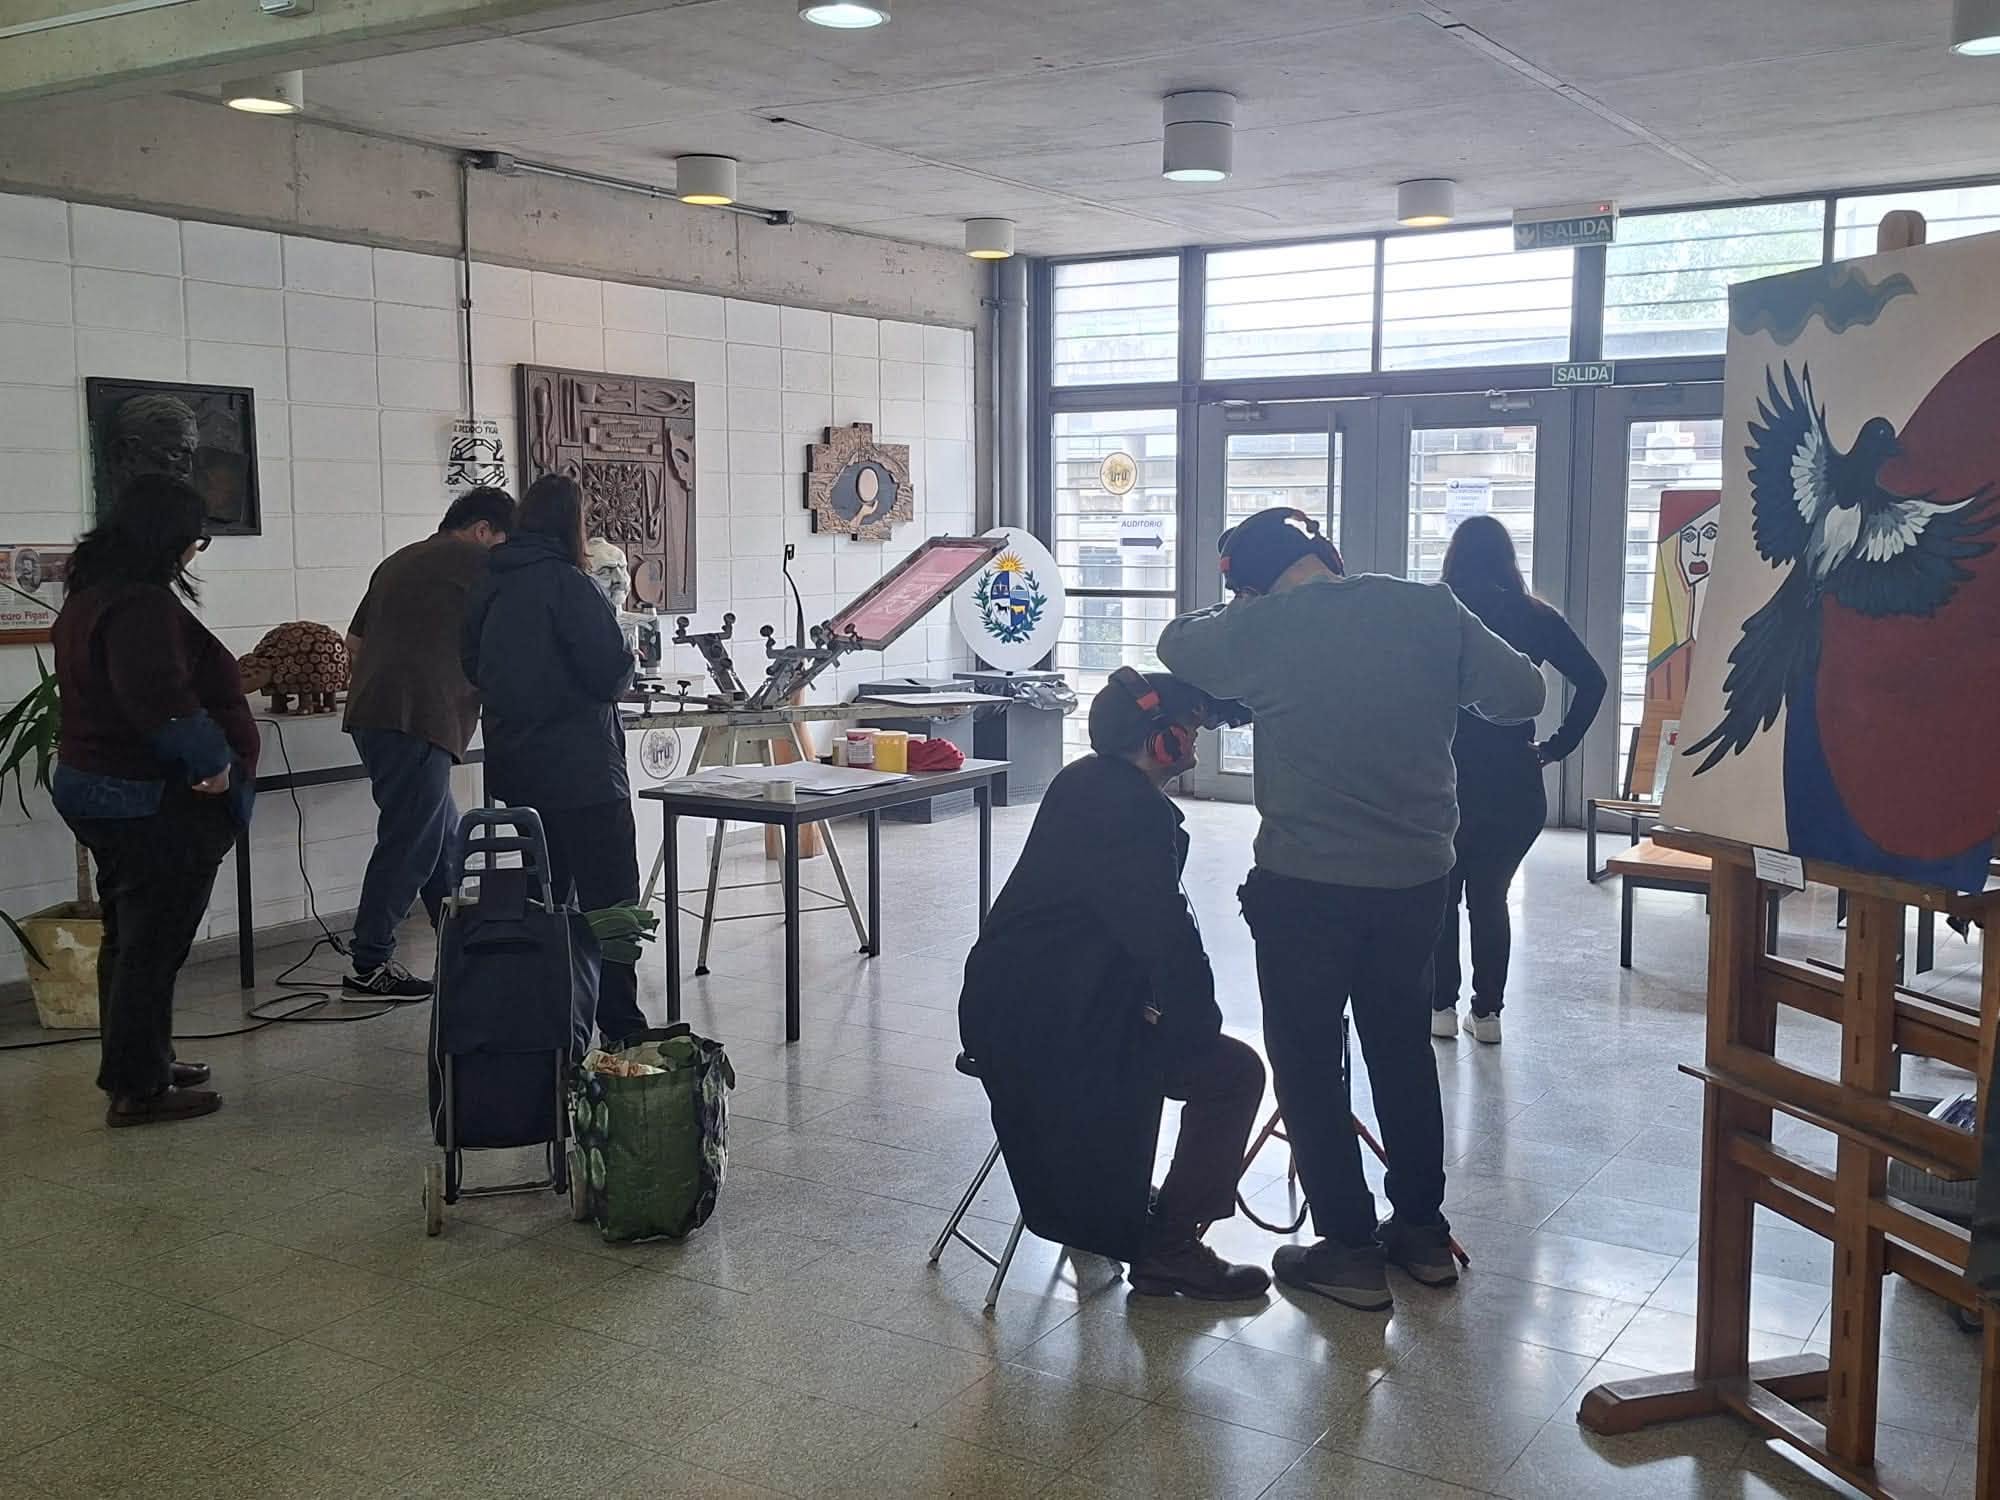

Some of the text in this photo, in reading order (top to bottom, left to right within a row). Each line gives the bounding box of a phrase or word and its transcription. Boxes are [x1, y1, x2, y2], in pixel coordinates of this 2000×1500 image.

[1543, 218, 1611, 239] SALIDA
[1557, 366, 1609, 382] SALIDA
[1121, 520, 1162, 528] AUDITORIO
[0, 612, 22, 621] edro
[653, 744, 670, 764] UTU
